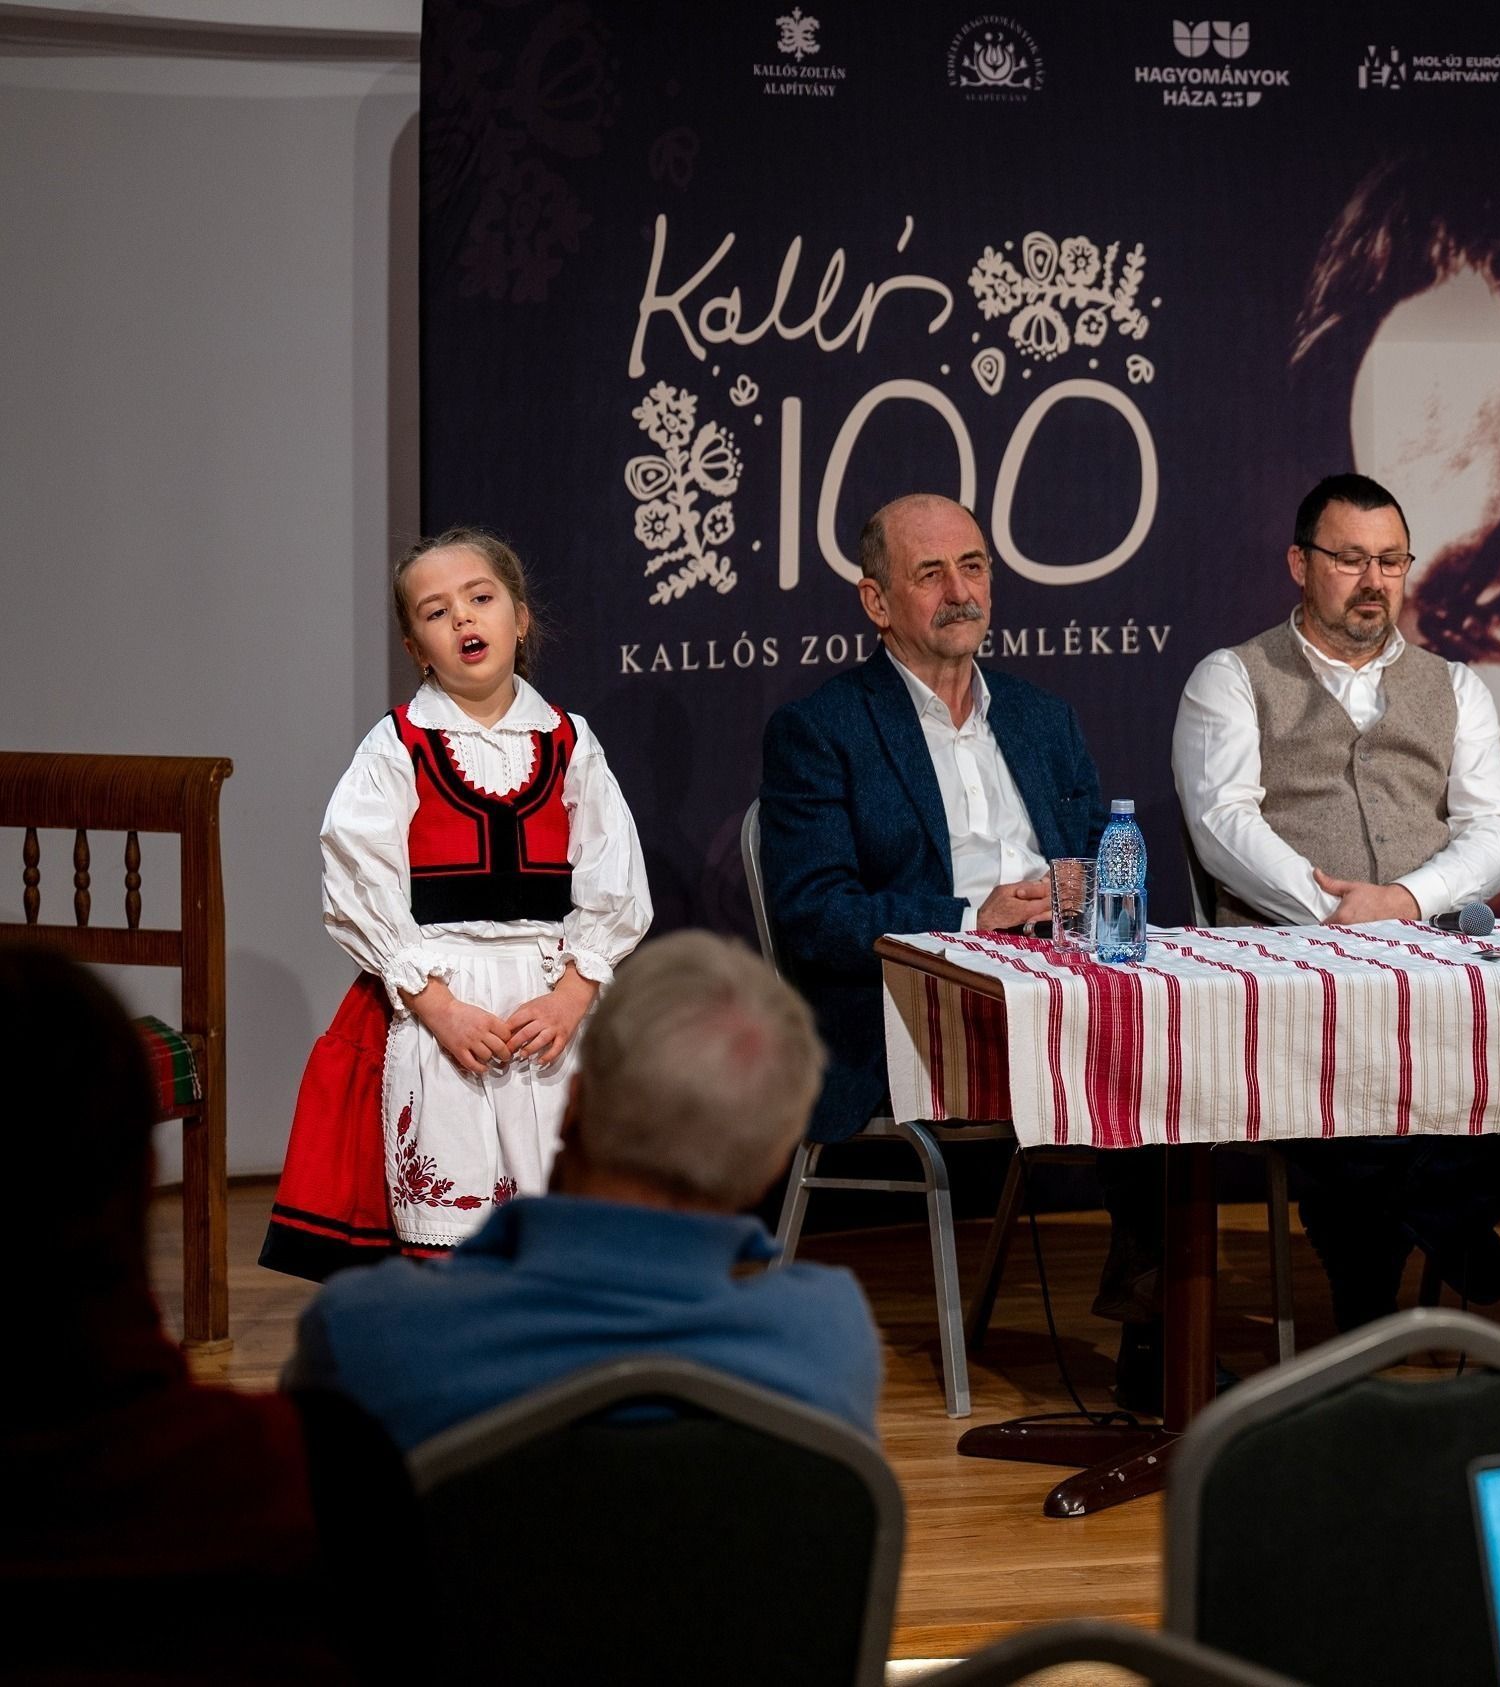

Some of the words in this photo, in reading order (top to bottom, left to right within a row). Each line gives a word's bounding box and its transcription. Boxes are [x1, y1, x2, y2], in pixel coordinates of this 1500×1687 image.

[753, 63, 798, 77] KALLÓS
[799, 65, 847, 80] ZOLTÁN
[1134, 64, 1290, 87] HAGYOMÁNYOK
[1413, 69, 1500, 82] ALAPÍTVÁNY
[763, 81, 836, 97] ALAPÍTVÁNY
[1163, 86, 1218, 107] HÁZA
[1221, 91, 1244, 107] 25
[779, 378, 1160, 591] 100
[620, 630, 780, 674] KALLÓS
[800, 633, 882, 665] ZOL
[976, 618, 1172, 658] EMLÉKÉV
